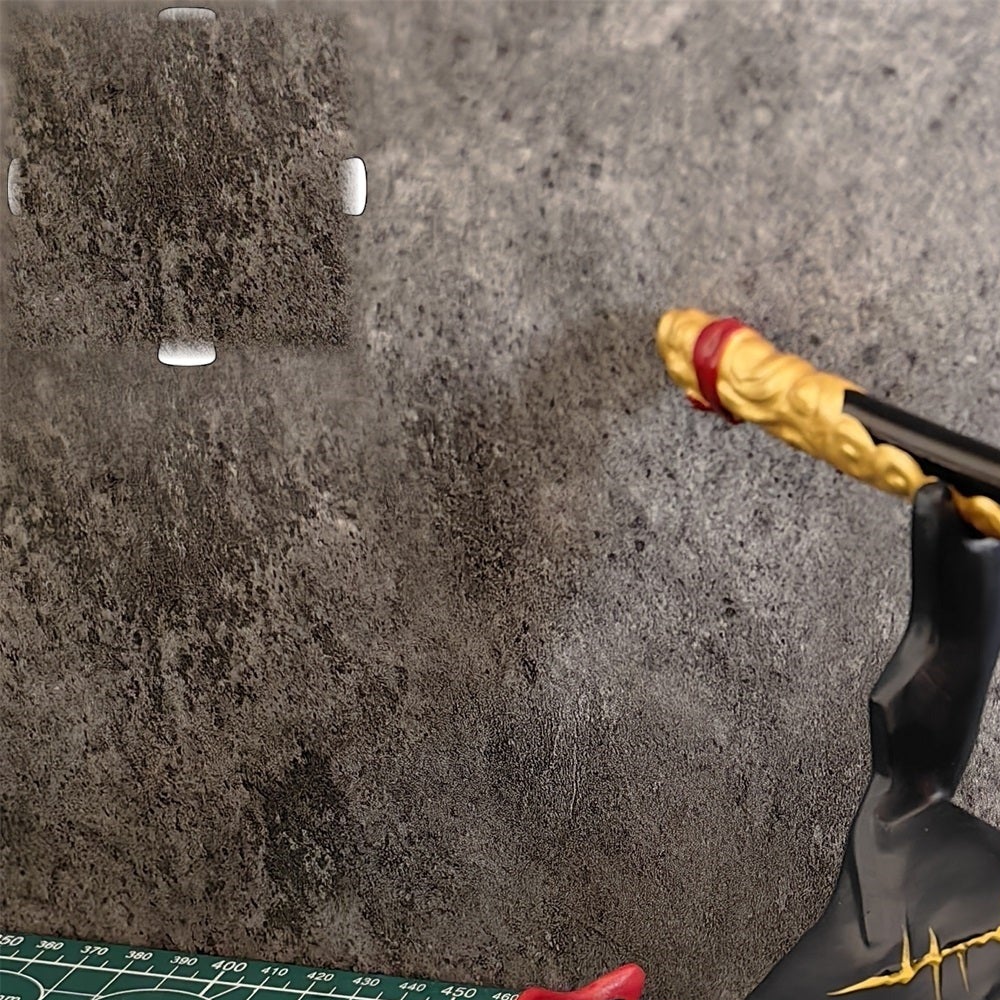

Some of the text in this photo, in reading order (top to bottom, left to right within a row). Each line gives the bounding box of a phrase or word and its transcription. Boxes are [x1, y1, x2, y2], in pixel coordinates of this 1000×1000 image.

[36, 940, 64, 950] 360
[80, 945, 109, 956] 370
[125, 950, 153, 961] 380
[170, 955, 198, 966] 390
[211, 960, 248, 972] 400
[260, 966, 288, 977] 410
[306, 972, 334, 983] 420
[352, 977, 380, 988] 430
[399, 982, 427, 993] 440
[440, 986, 477, 999] 450
